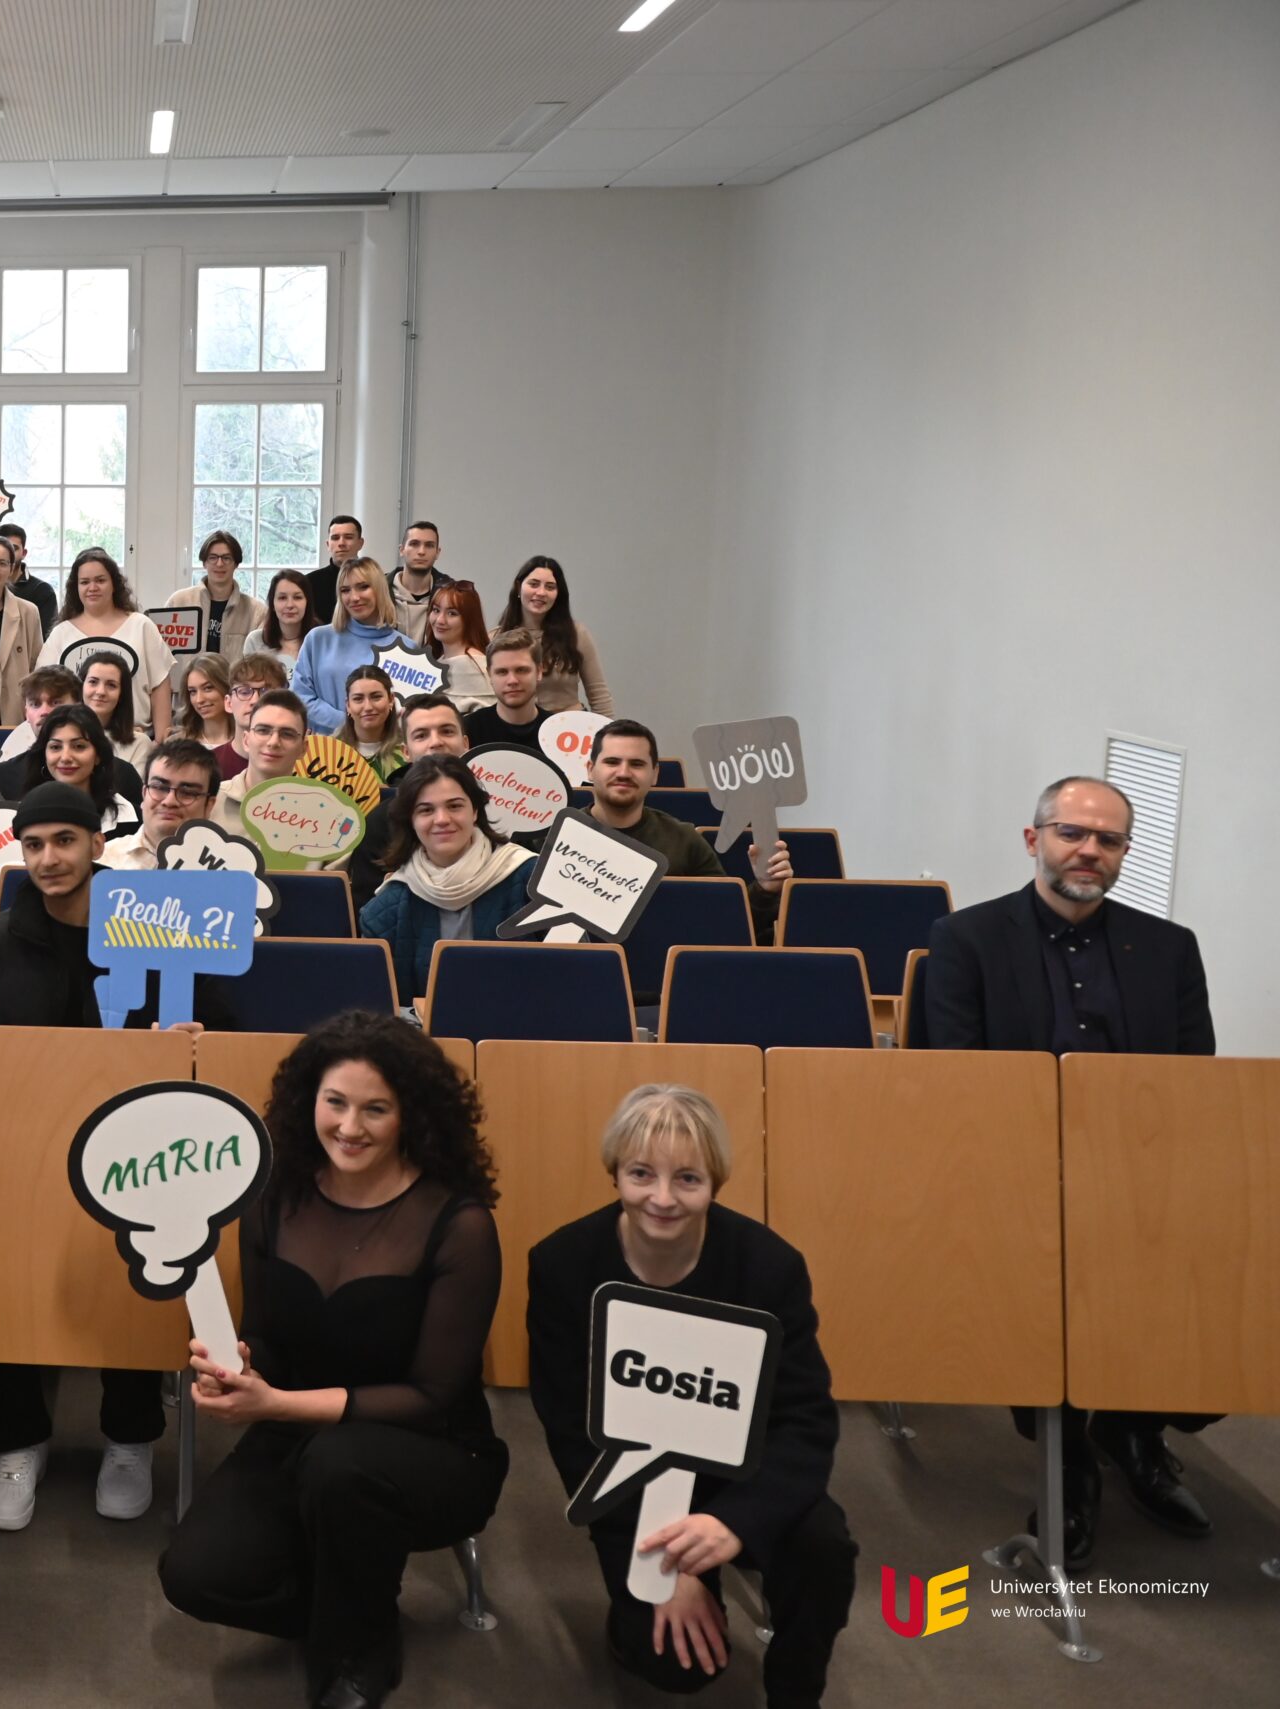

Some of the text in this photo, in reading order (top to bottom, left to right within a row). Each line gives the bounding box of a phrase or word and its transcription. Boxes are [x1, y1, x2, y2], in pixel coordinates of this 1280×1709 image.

[157, 624, 194, 636] LOVE
[171, 613, 178, 623] I
[382, 659, 437, 691] FRANCE!
[545, 789, 562, 803] to
[252, 801, 319, 833] cheers
[559, 863, 622, 904] Student
[108, 888, 191, 947] Really
[102, 1135, 242, 1195] MARIA
[610, 1349, 740, 1411] Gosia
